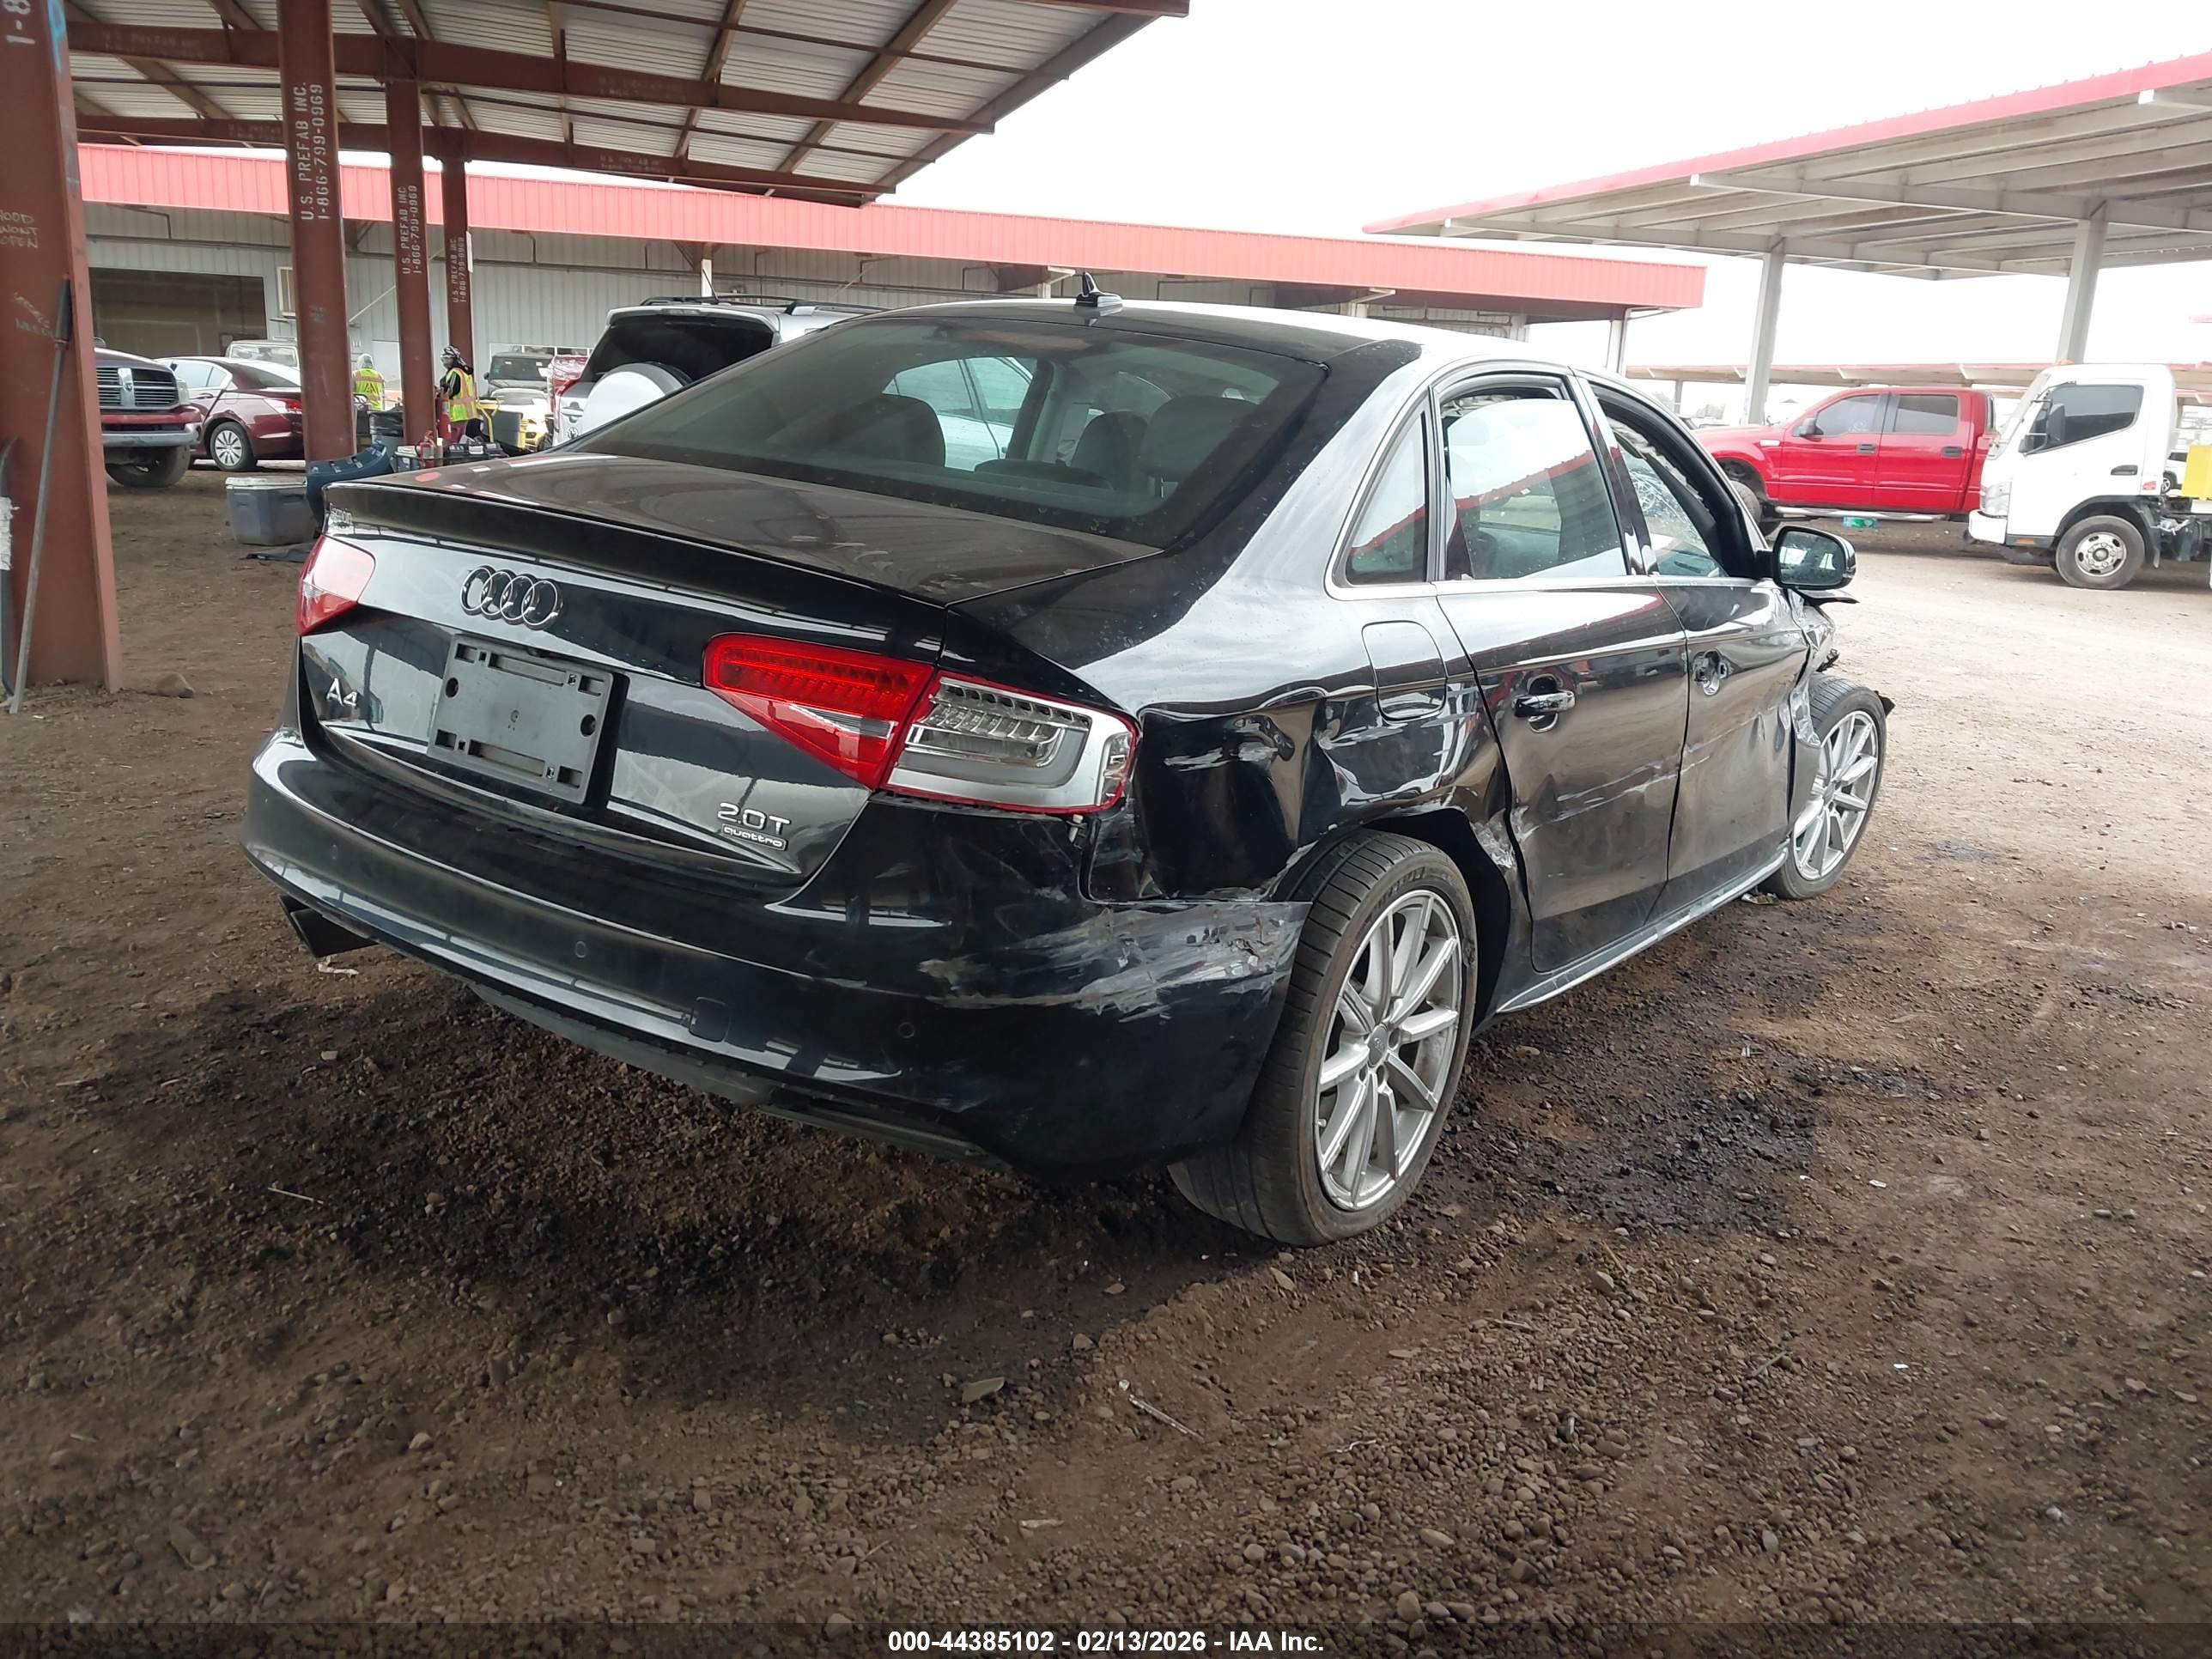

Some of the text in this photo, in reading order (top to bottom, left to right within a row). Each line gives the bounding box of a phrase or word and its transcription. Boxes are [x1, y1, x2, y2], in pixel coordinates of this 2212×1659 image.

[293, 82, 314, 221] U.S. PREFAB INC.
[309, 83, 331, 221] 1-866-799-0969
[398, 209, 410, 249] PREFAB
[326, 678, 358, 707] A4
[717, 802, 791, 836] 2.0T
[723, 825, 783, 848] quattro
